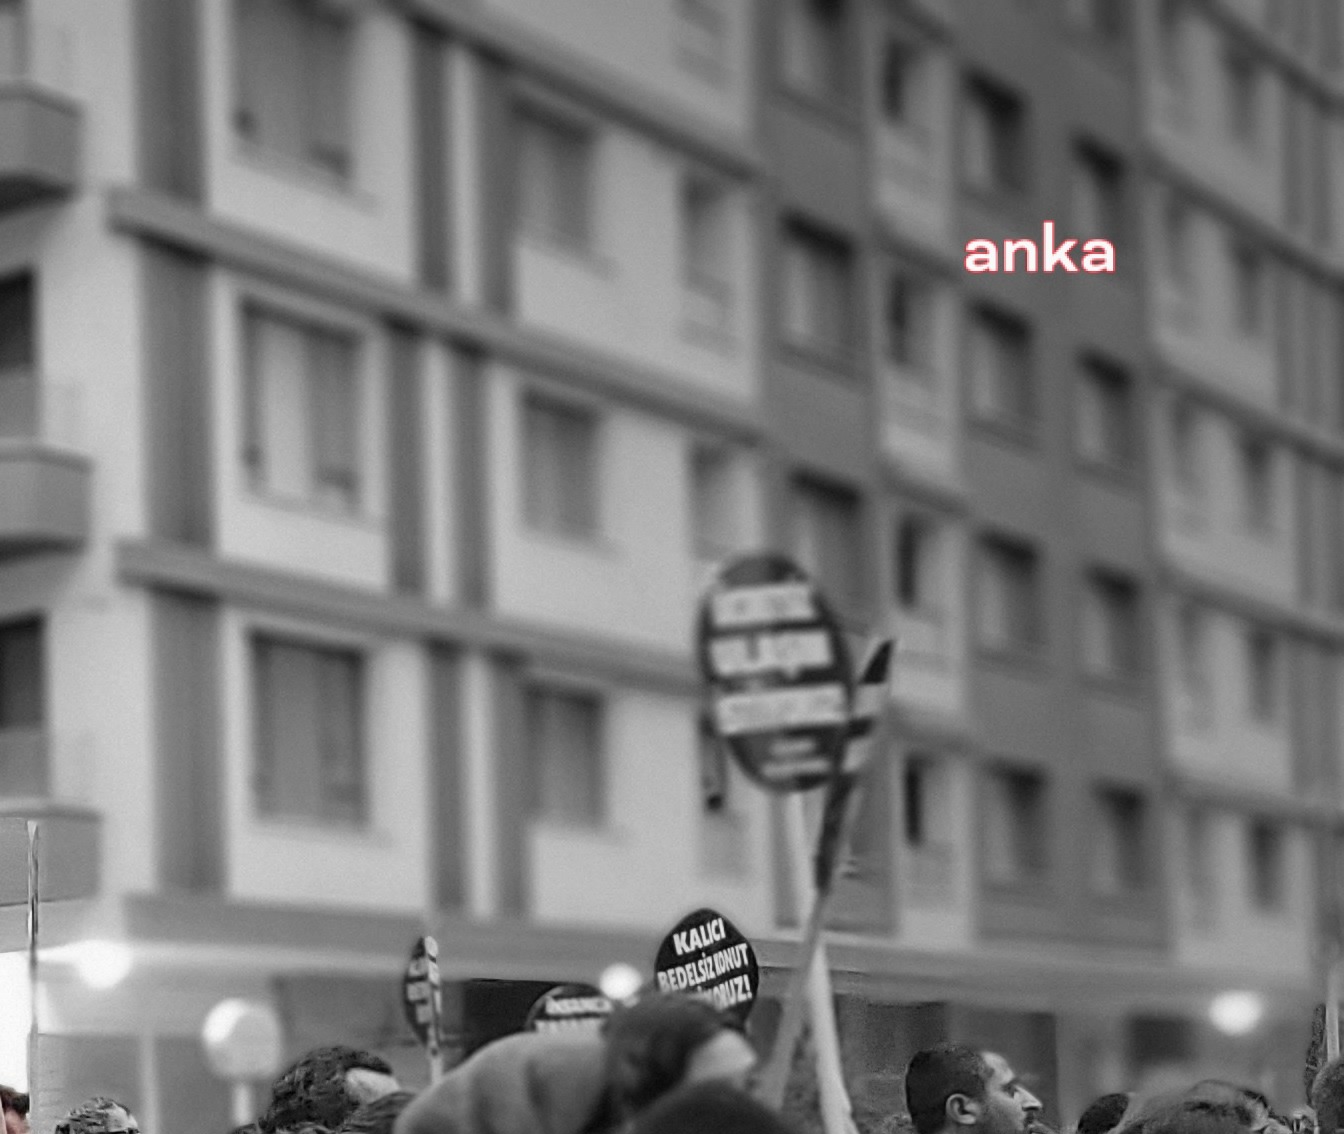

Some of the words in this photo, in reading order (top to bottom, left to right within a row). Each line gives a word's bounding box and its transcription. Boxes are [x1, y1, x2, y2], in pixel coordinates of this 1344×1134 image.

[673, 917, 726, 956] KALICI
[657, 951, 716, 993] BEDELSİZ
[712, 943, 749, 977] KONUT
